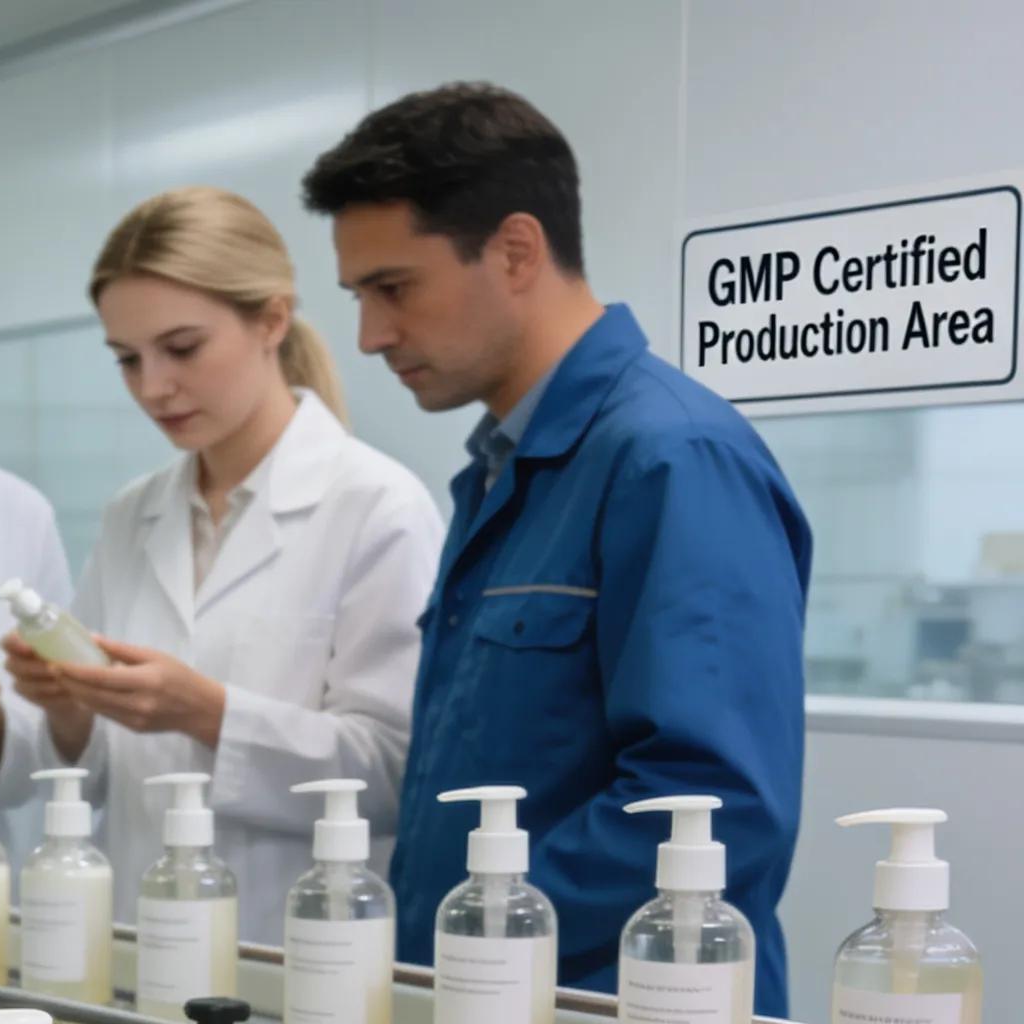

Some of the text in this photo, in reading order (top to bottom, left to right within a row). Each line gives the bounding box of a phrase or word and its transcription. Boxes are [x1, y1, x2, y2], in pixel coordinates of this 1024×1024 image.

[708, 227, 987, 307] GMP Certified
[698, 300, 994, 368] Production Area
